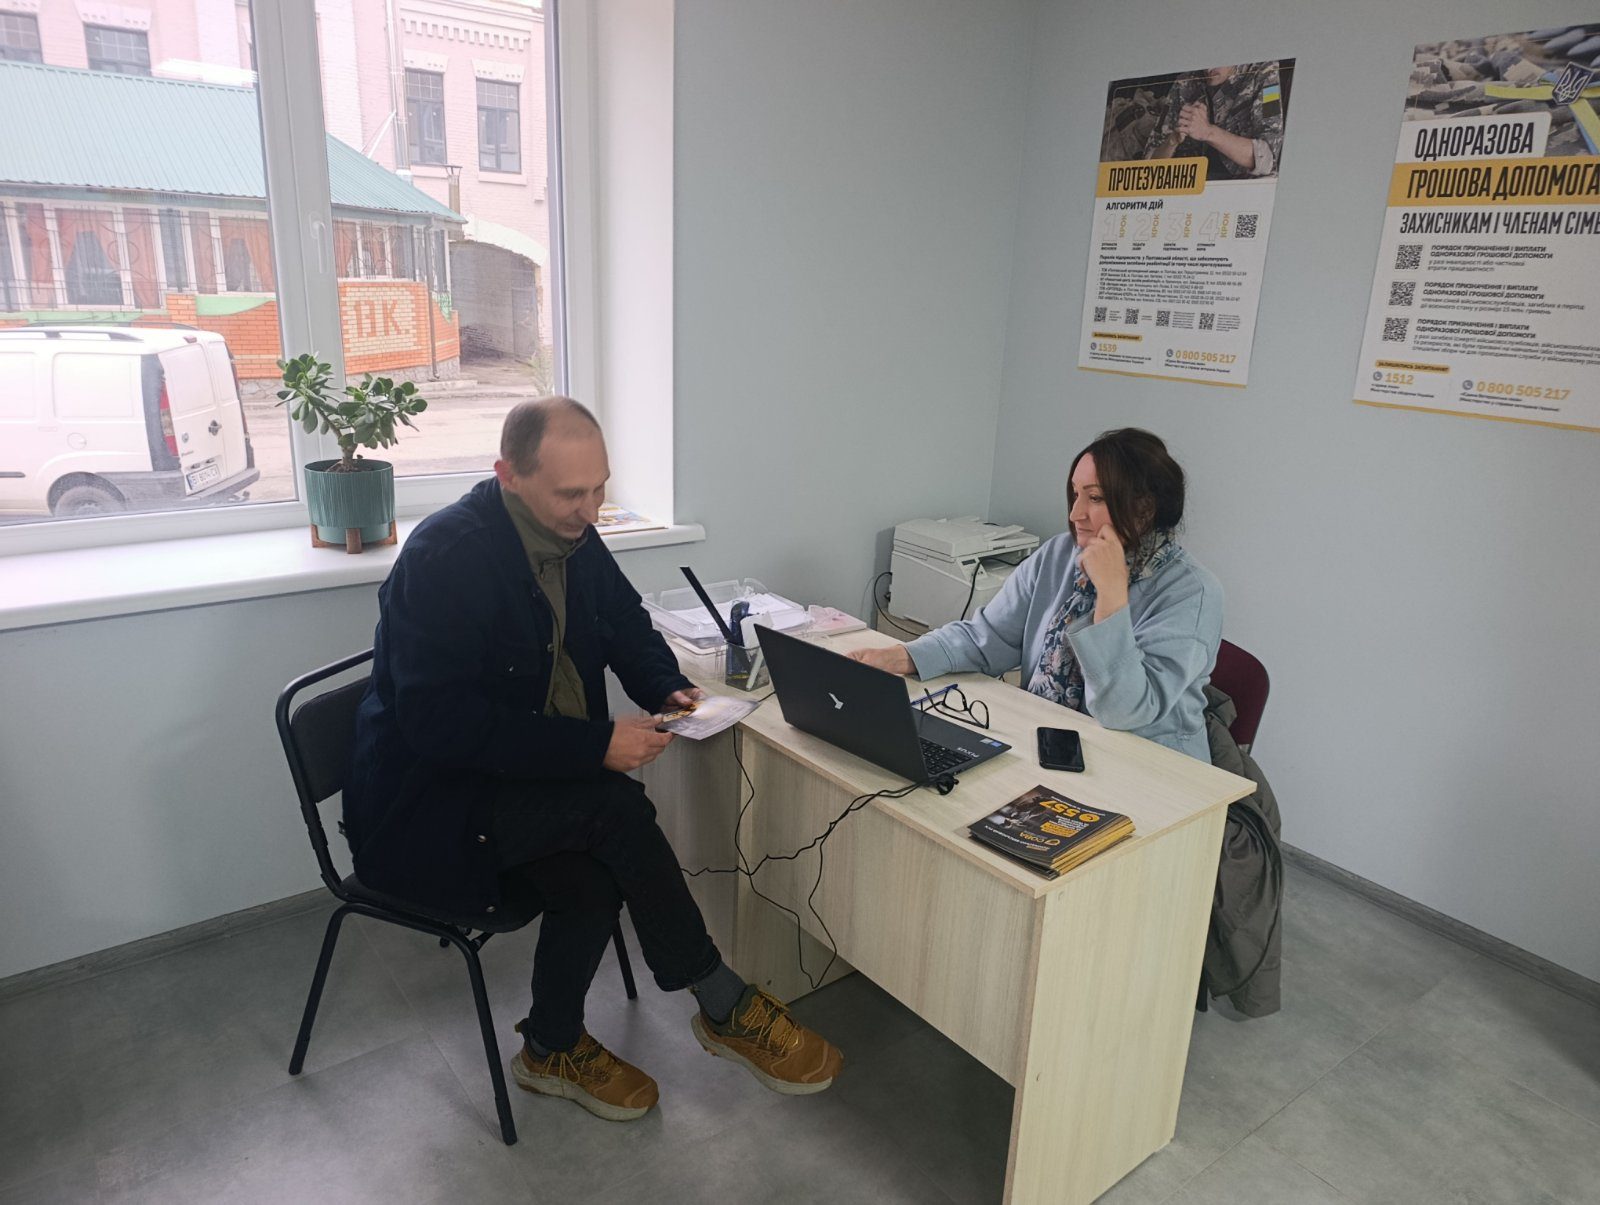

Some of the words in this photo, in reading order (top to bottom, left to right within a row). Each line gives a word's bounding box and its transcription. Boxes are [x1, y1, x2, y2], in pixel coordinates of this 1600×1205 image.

[1415, 122, 1534, 161] ОДНОРАЗОВА
[1108, 164, 1198, 191] ПРОТЕЗУВАННЯ
[1407, 167, 1492, 198] ГРОШОВА
[1492, 164, 1600, 200] ДОПОМОГА
[1106, 201, 1147, 211] АЛГОРИТМ
[1148, 199, 1163, 210] ДІЙ
[1400, 212, 1492, 234] ЗАХИСНИКАМ
[1494, 212, 1499, 234] І
[1503, 212, 1563, 234] ЧЛЕНАМ
[1176, 350, 1181, 359] 0
[1182, 351, 1199, 360] 800
[1201, 352, 1218, 362] 505
[1219, 354, 1236, 363] 217
[1385, 373, 1414, 384] 1512
[1477, 381, 1485, 392] 0
[1487, 383, 1513, 394] 800
[1516, 385, 1542, 397] 505
[1544, 388, 1570, 400] 217
[1039, 800, 1080, 817] 557
